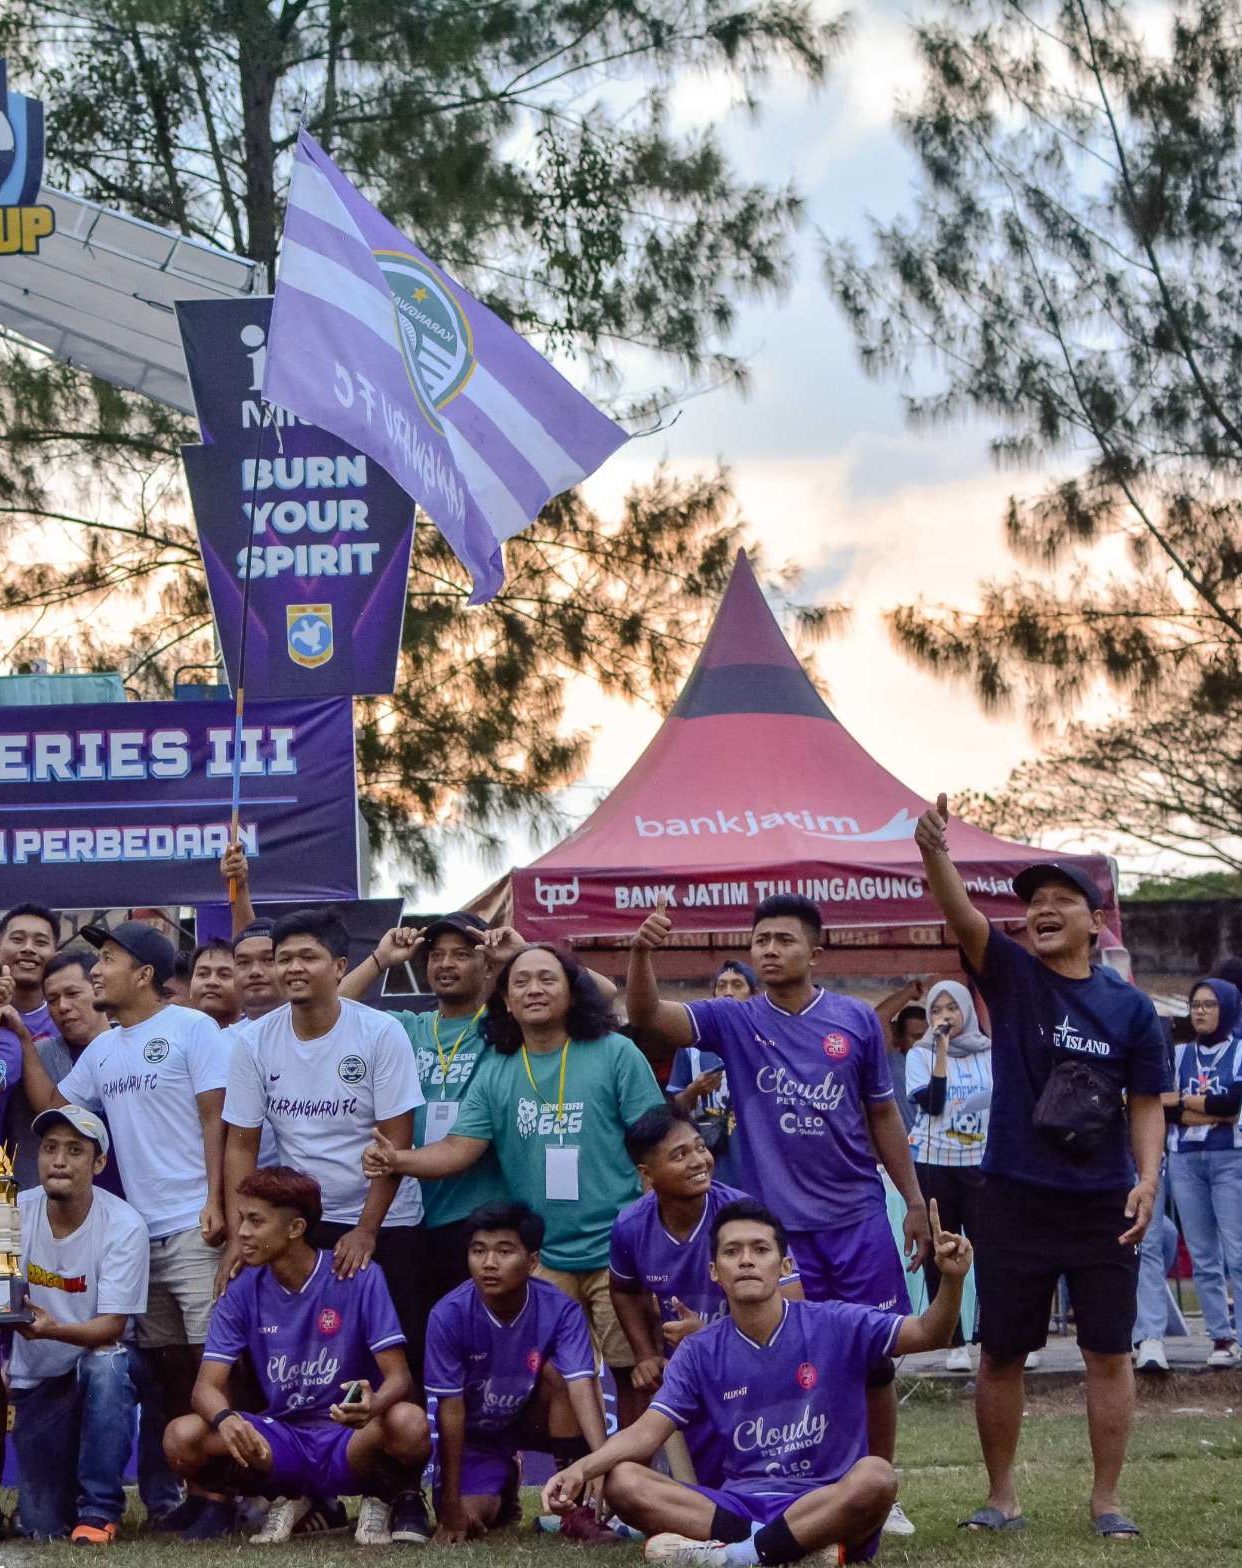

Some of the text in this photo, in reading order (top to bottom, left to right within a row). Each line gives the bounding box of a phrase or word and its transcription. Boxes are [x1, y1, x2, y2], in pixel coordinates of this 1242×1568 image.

[242, 455, 367, 491] BURN
[242, 499, 369, 534] YOUR
[236, 542, 380, 579] SPIRIT
[206, 727, 297, 777] III
[635, 810, 860, 838] bankjatim
[13, 822, 260, 864] PERBEDAAN
[614, 884, 678, 909] BANK
[683, 881, 749, 907] JATIM
[1065, 1034, 1110, 1056] ISLAND
[144, 1073, 158, 1092] FC
[756, 1065, 846, 1111] Cloudy
[269, 1096, 358, 1119] KARANGWARU FC
[800, 1099, 829, 1111] SND
[538, 1111, 583, 1136] 625
[779, 1111, 824, 1134] CLEO
[266, 1347, 340, 1385] Cloudy
[733, 1404, 829, 1452] Cloudy
[760, 1438, 813, 1458] PET SAND
